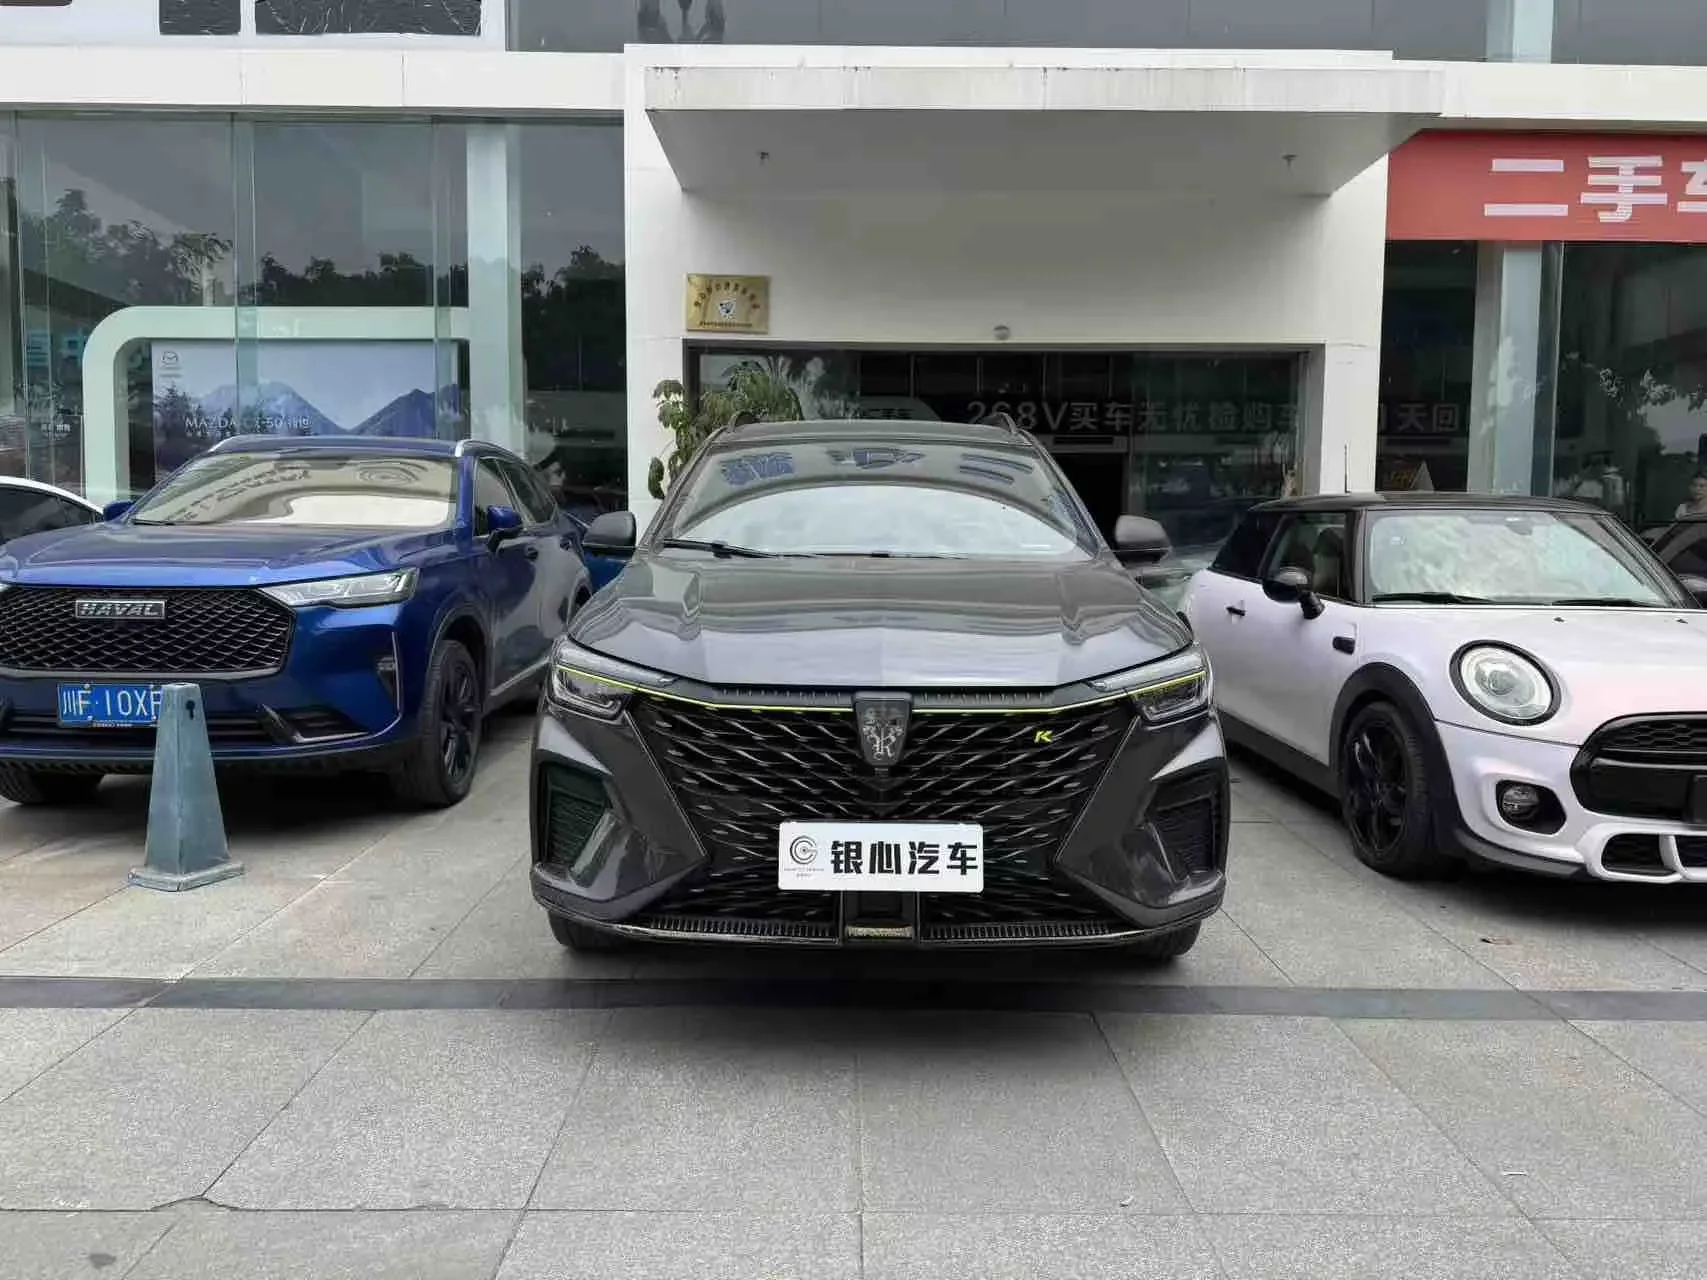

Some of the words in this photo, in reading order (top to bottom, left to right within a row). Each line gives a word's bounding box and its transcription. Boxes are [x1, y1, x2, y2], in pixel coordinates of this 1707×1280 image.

[80, 603, 159, 616] HAVAL
[831, 841, 979, 875] 银心汽车
